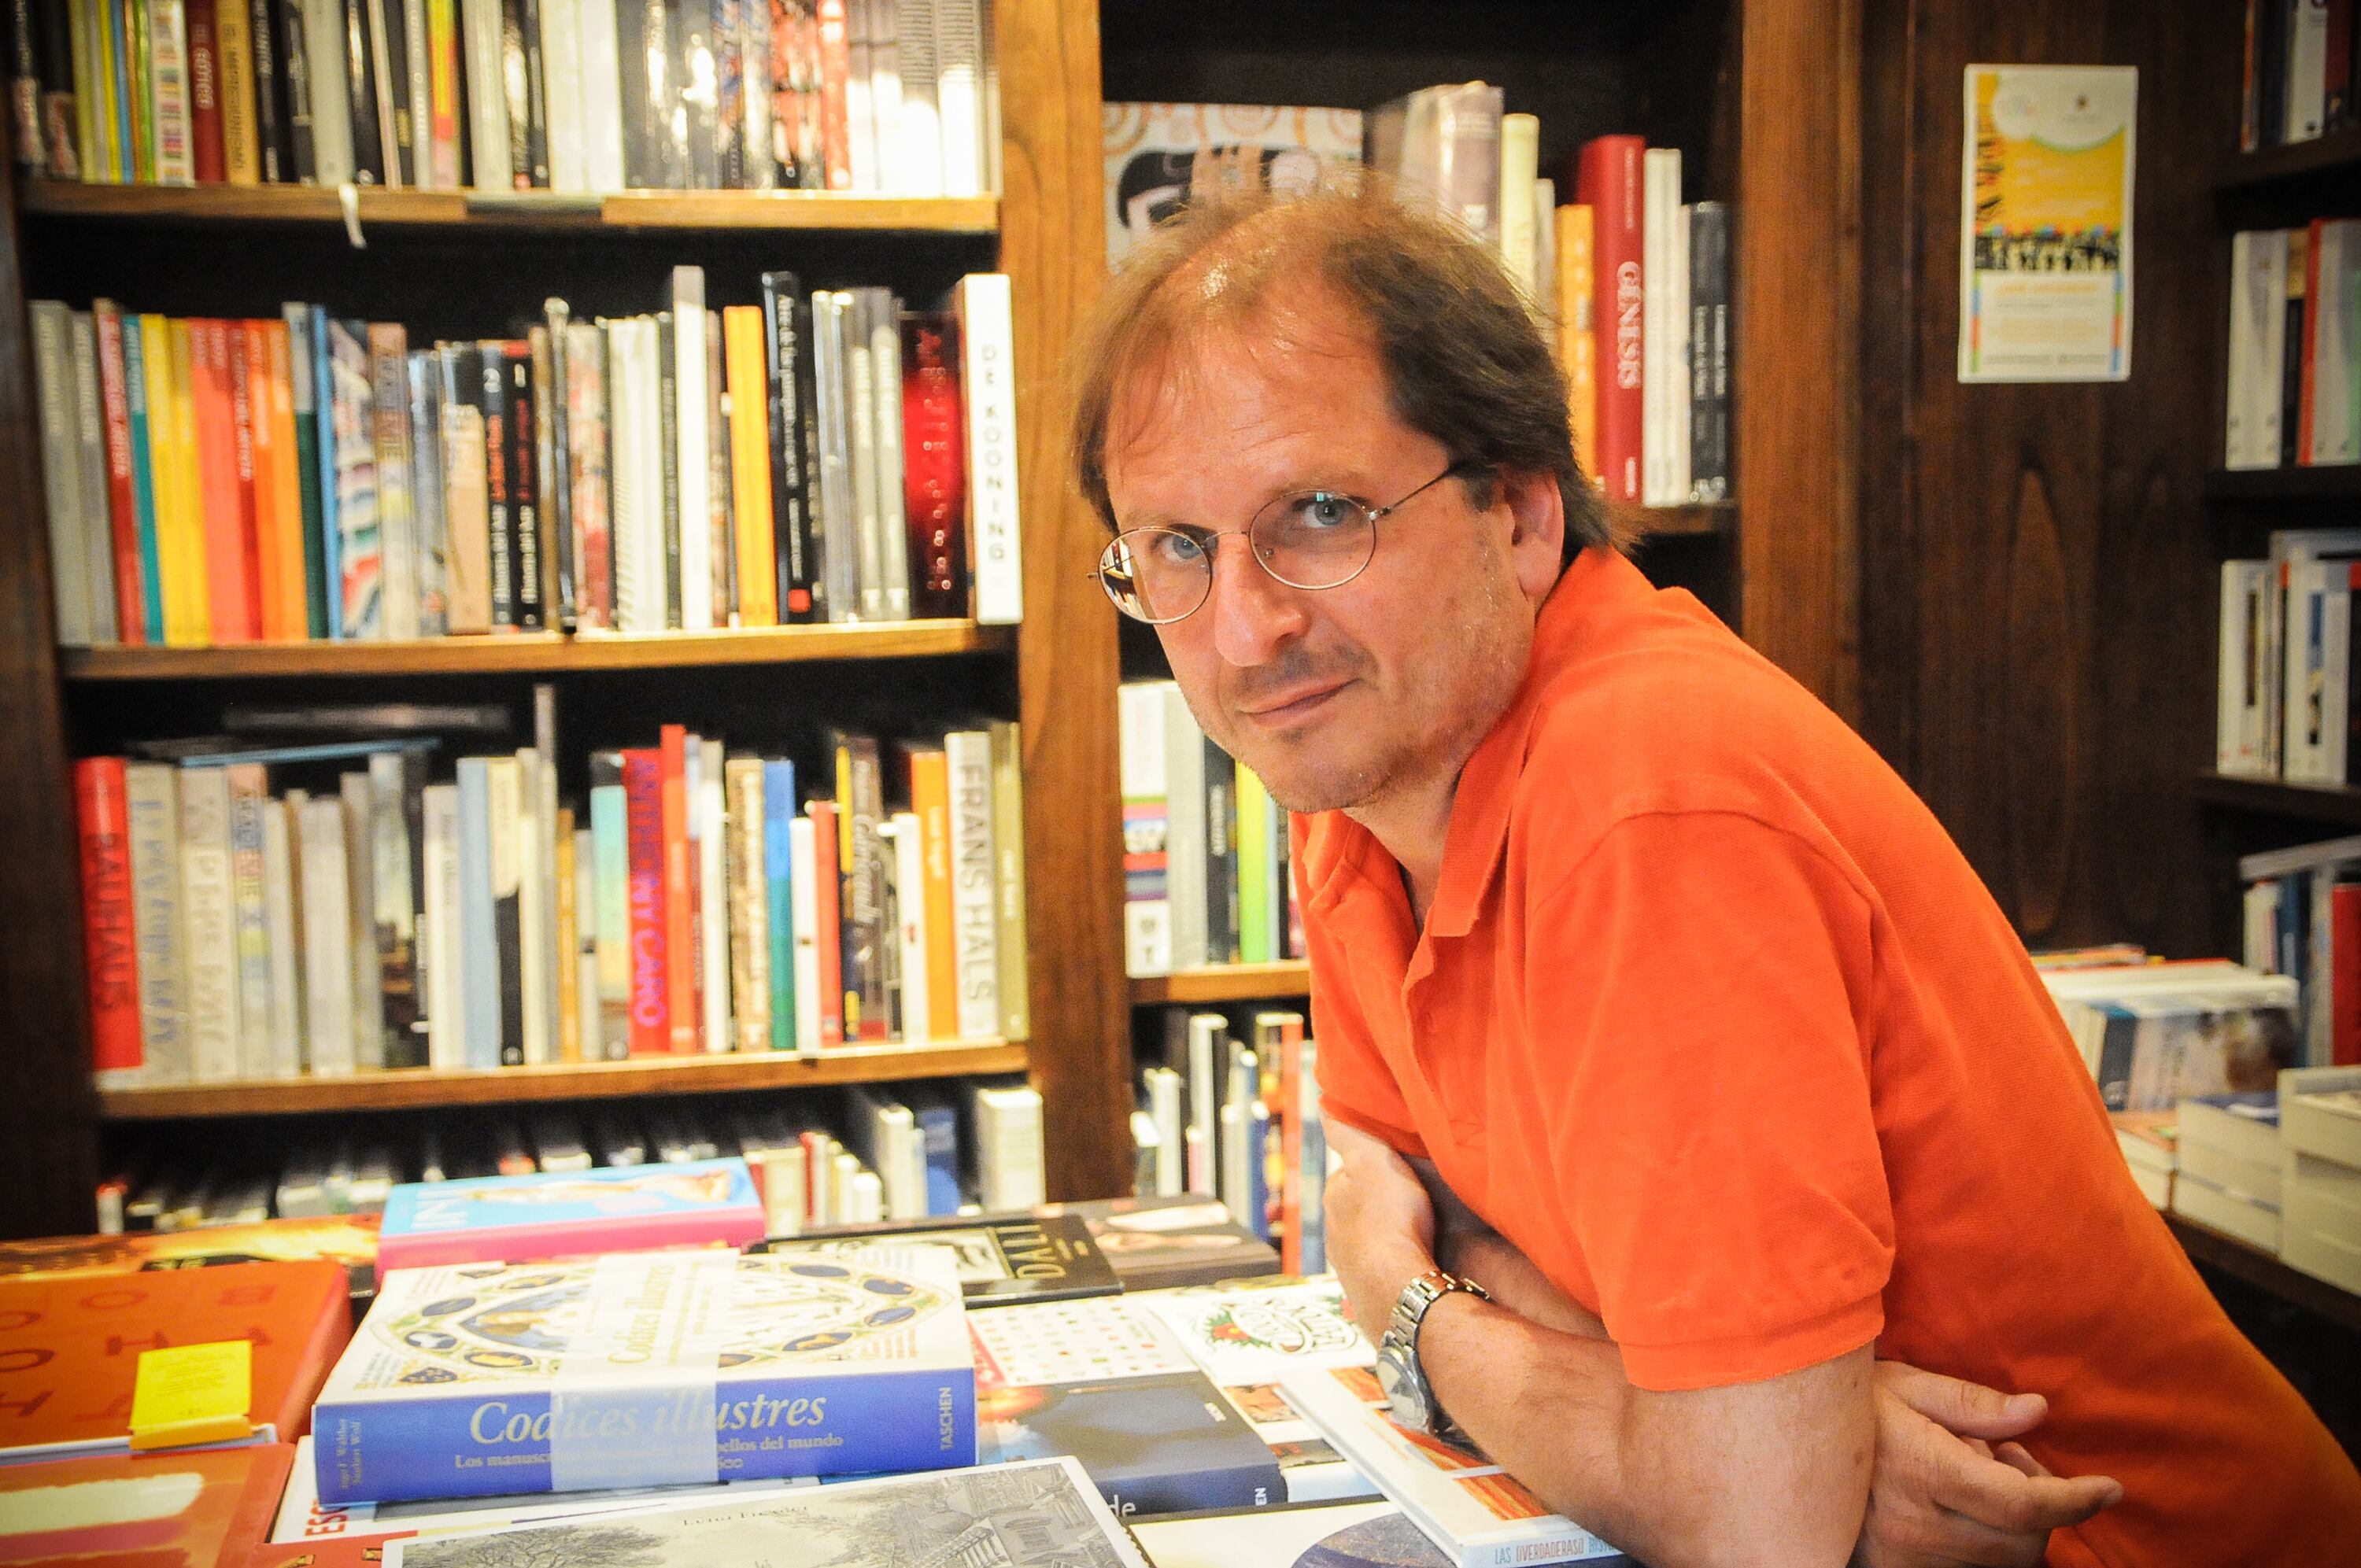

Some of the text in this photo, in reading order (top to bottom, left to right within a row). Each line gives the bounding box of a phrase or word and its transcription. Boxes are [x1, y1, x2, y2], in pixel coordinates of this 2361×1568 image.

[981, 343, 1006, 561] DE KOONING
[961, 765, 992, 1000] FRANS HALS
[470, 1390, 639, 1445] Codices
[939, 1386, 954, 1450] TASCHEN
